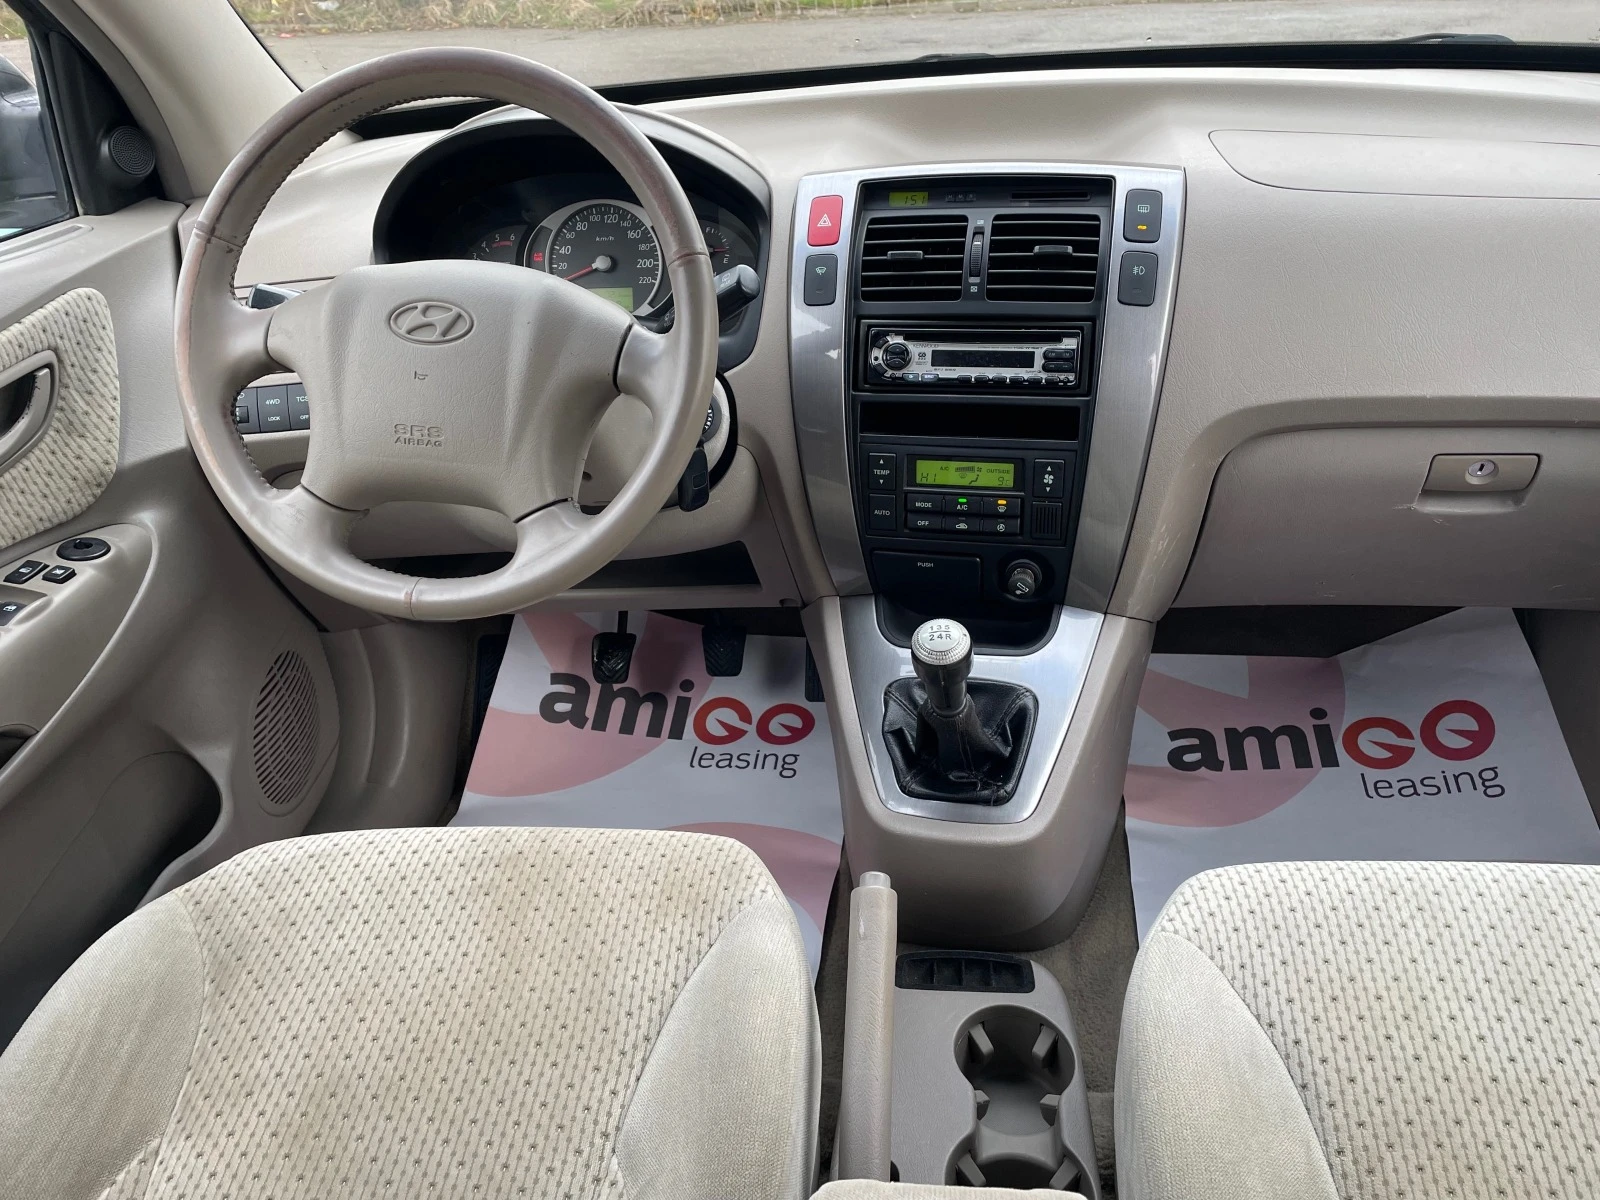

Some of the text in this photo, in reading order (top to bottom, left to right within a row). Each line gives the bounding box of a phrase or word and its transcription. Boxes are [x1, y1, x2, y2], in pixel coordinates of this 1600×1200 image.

[604, 214, 619, 223] 120
[576, 222, 588, 231] 80
[495, 234, 500, 242] 5
[510, 233, 515, 241] 6
[565, 231, 576, 239] 60
[627, 230, 641, 239] 160
[559, 246, 572, 254] 40
[637, 259, 654, 268] 200
[394, 424, 444, 439] SRS
[395, 436, 443, 447] AIRBAG
[689, 746, 800, 779] leasing
[1360, 766, 1506, 799] leasing
